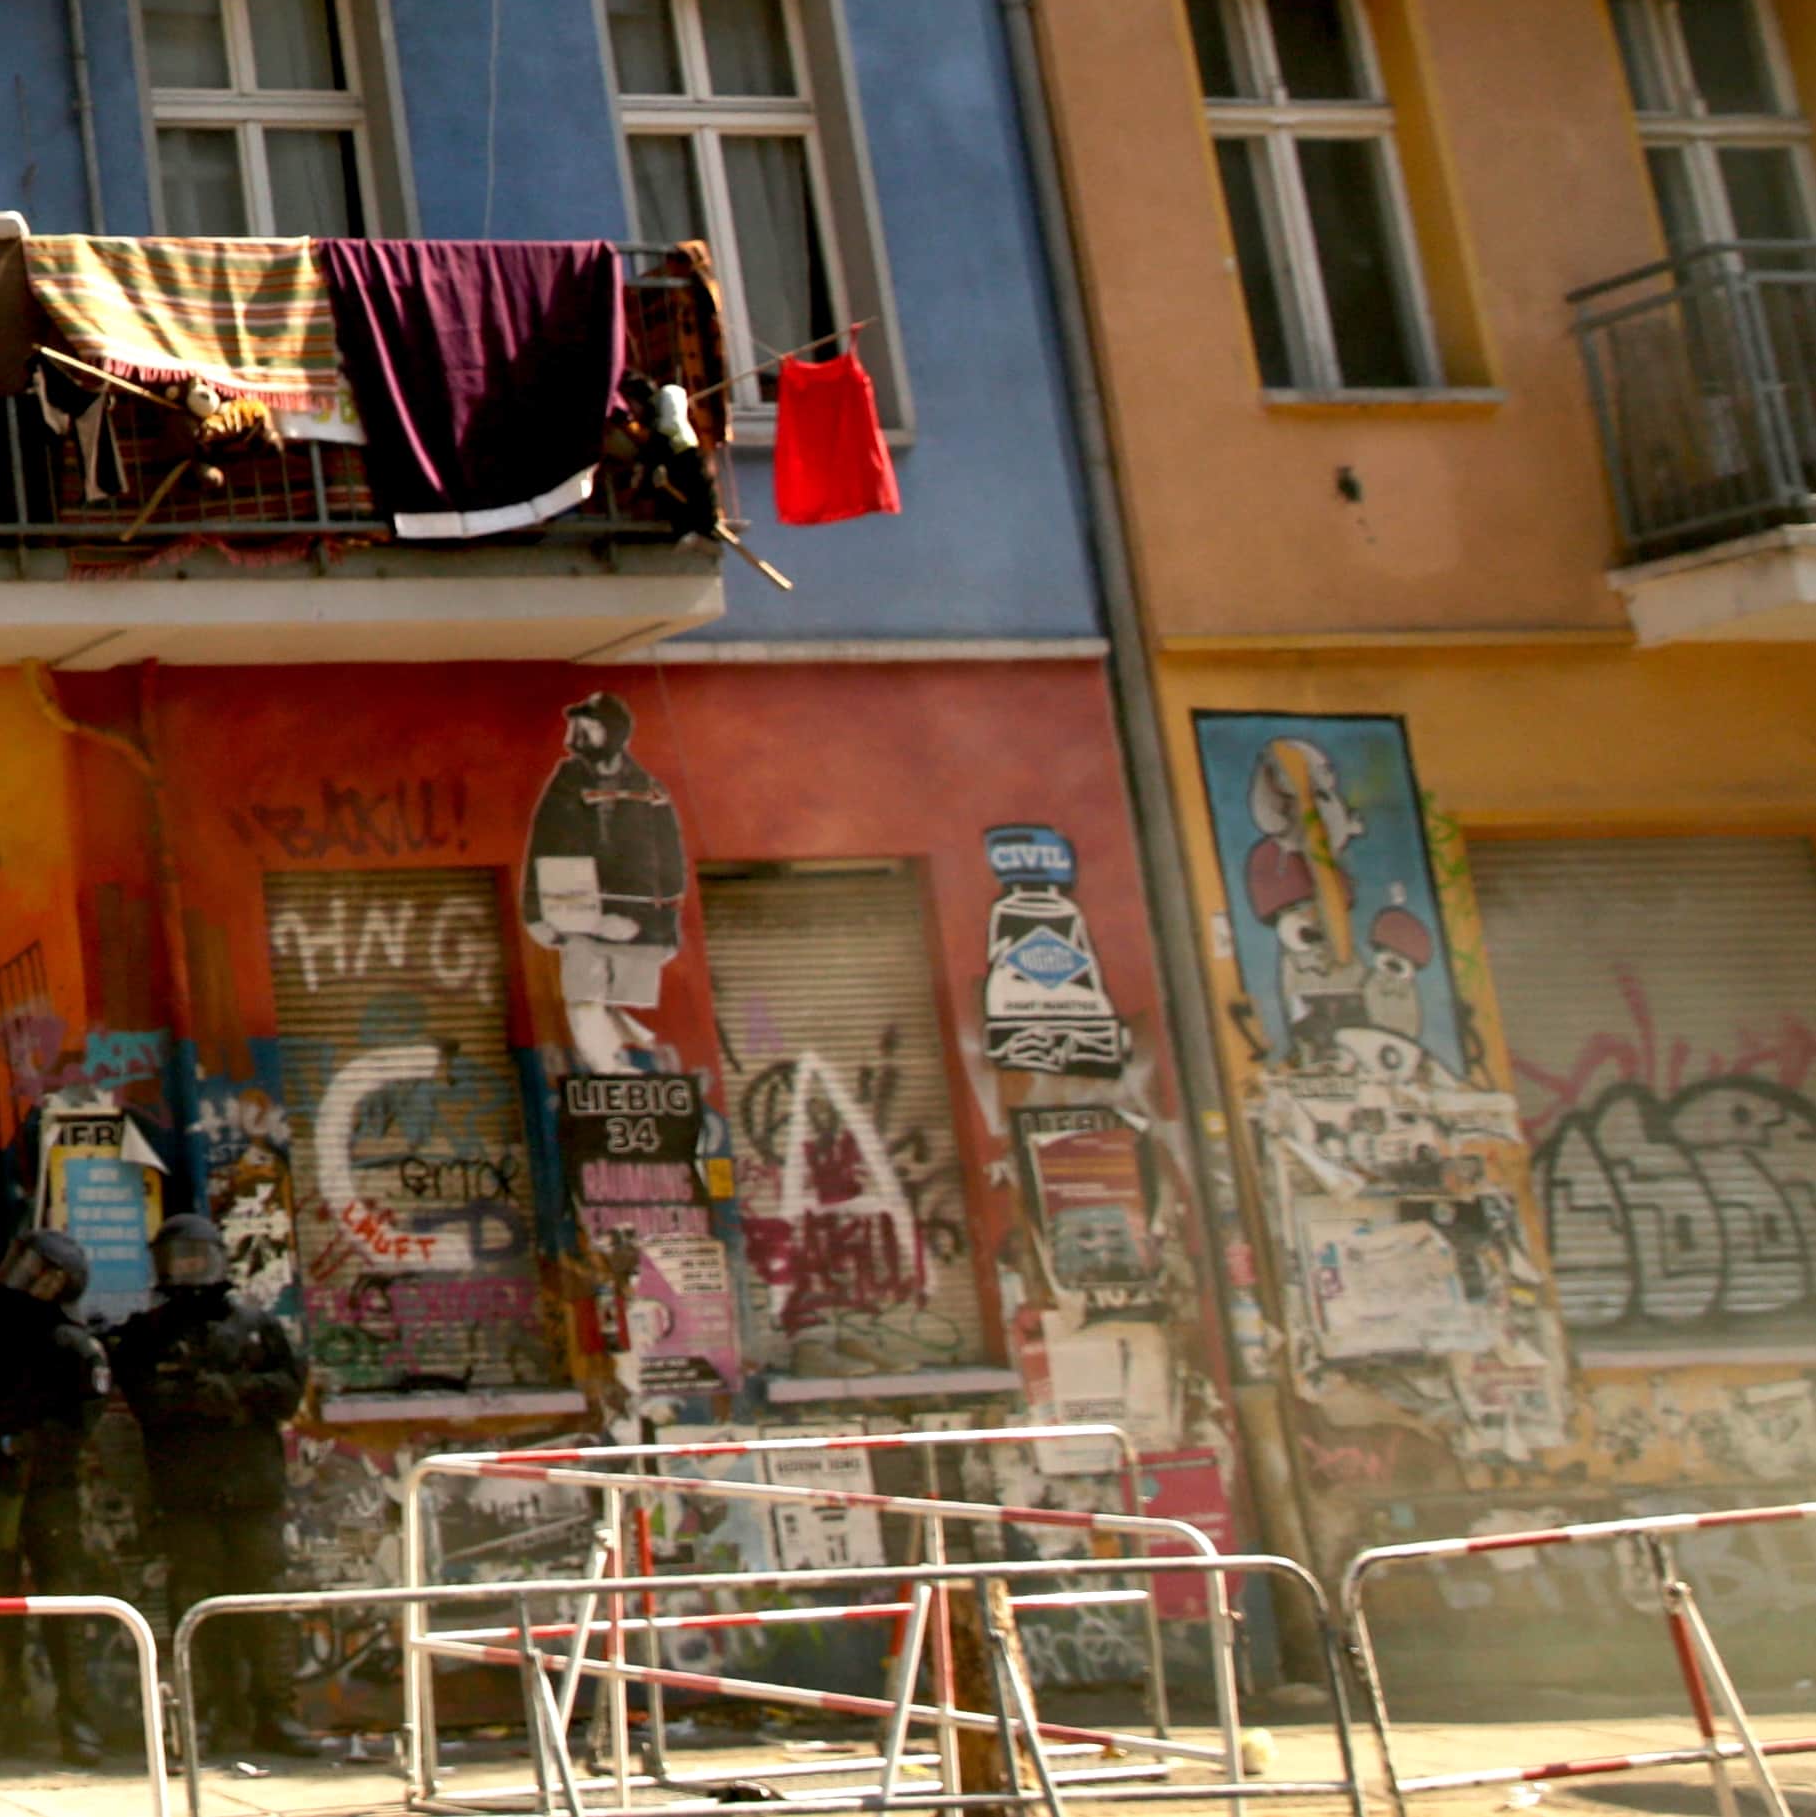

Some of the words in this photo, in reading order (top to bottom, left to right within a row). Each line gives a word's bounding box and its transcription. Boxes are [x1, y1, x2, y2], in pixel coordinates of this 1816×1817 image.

[990, 844, 1071, 871] CIVIL
[567, 1079, 694, 1115] LIEBIG
[607, 1116, 662, 1153] 34
